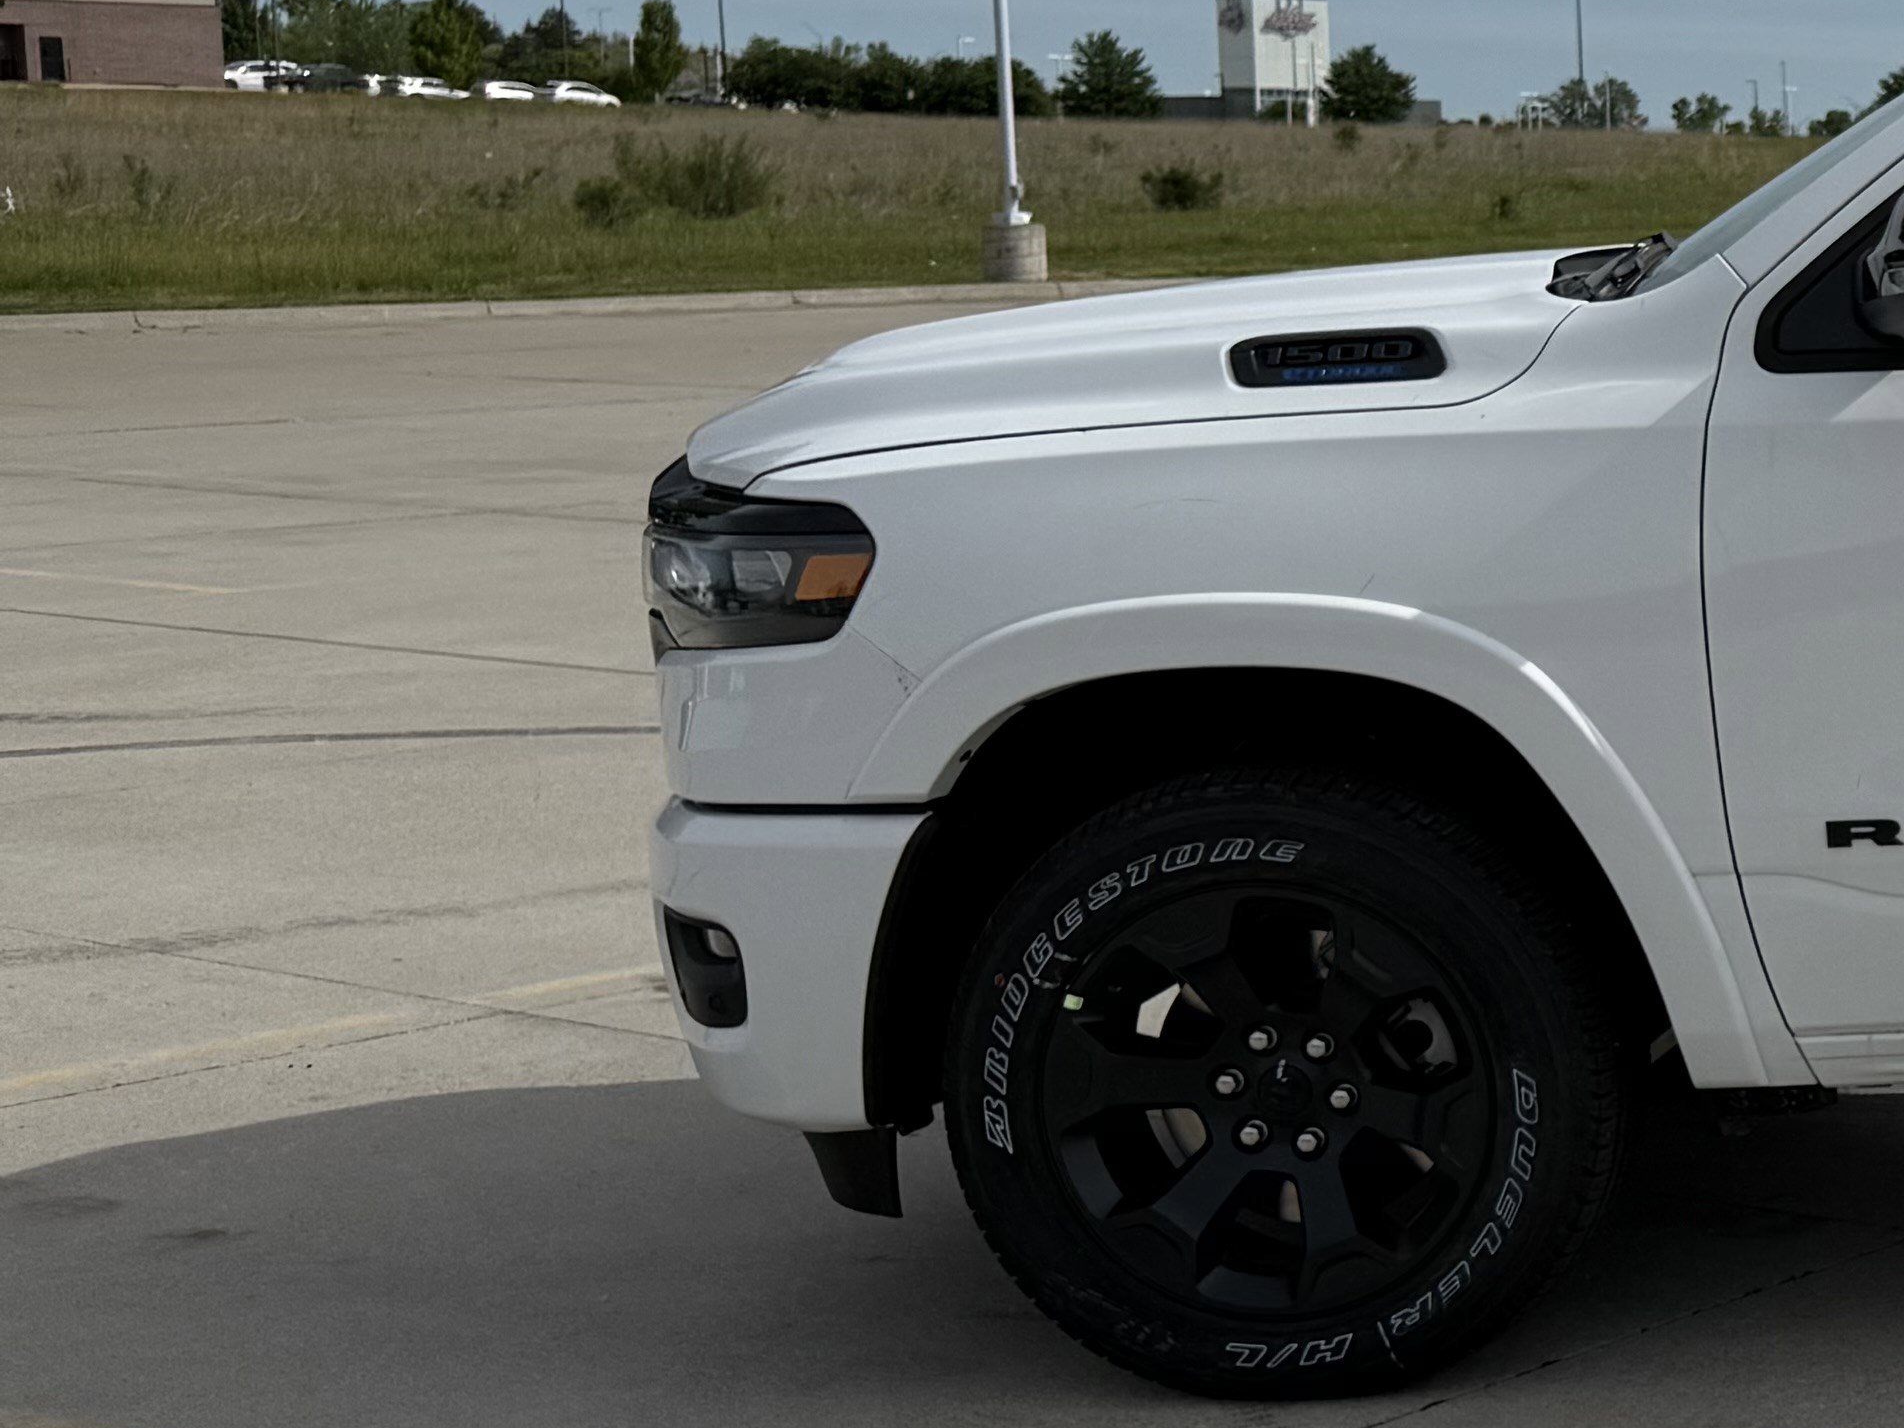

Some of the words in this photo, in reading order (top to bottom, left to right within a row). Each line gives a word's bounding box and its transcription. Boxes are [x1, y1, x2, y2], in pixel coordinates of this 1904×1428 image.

[1261, 340, 1412, 366] 1500
[983, 837, 1306, 1154] BRIDGESTONE
[1390, 1068, 1540, 1336] DUELER
[1225, 1332, 1353, 1368] H/L
